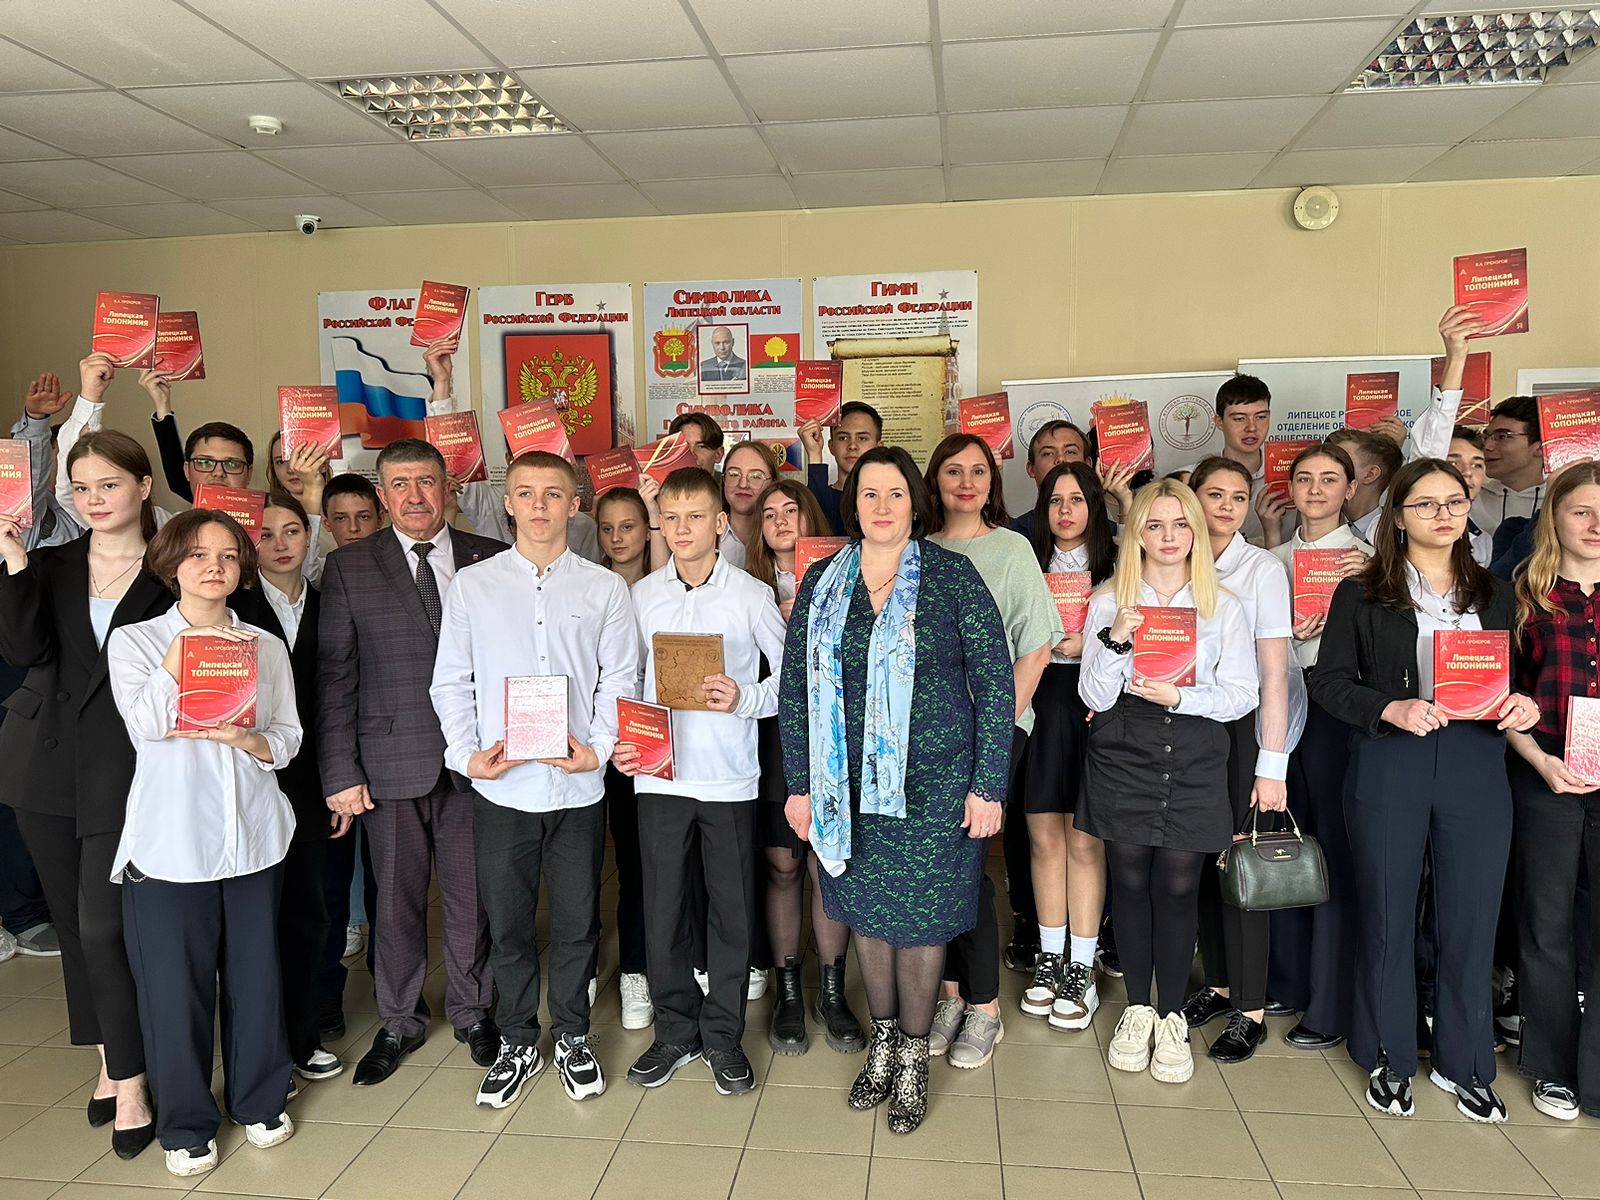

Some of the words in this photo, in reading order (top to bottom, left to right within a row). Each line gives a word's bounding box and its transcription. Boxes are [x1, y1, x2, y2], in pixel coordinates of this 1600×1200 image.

[1471, 273, 1512, 283] Липецкая
[1464, 278, 1519, 292] ТОПОНИМИЯ
[428, 299, 455, 307] Липецкая
[424, 304, 458, 314] ТОПОНИМИЯ
[108, 311, 144, 319] Липецкая
[103, 317, 149, 326] ТОПОНИМИЯ
[971, 412, 999, 420] Липецкая
[1288, 411, 1336, 420] ЛИПЕЦКОЕ
[1556, 410, 1596, 420] Липецкая
[517, 417, 548, 431] Липецкая
[968, 416, 1004, 427] ТОПОНИМИЯ
[1108, 422, 1139, 431] Липецкая
[514, 421, 556, 439] ТОПОНИМИЯ
[1103, 426, 1144, 438] ТОПОНИМИЯ
[1277, 422, 1330, 432] ОТДЕЛЕНИЕ
[438, 431, 467, 439] Липецкая
[435, 437, 473, 446] ТОПОНИМИЯ
[598, 466, 632, 479] ТОПОНИМИЯ
[600, 463, 626, 473] Липецкая
[224, 510, 250, 518] ецкая
[1143, 634, 1190, 642] ТОПОНИМИЯ
[1452, 654, 1495, 662] Липецкая
[1446, 662, 1501, 670] ТОПОНИМИЯ
[629, 719, 659, 732] Липецкая
[626, 726, 664, 739] ТОПОНИМИЯ
